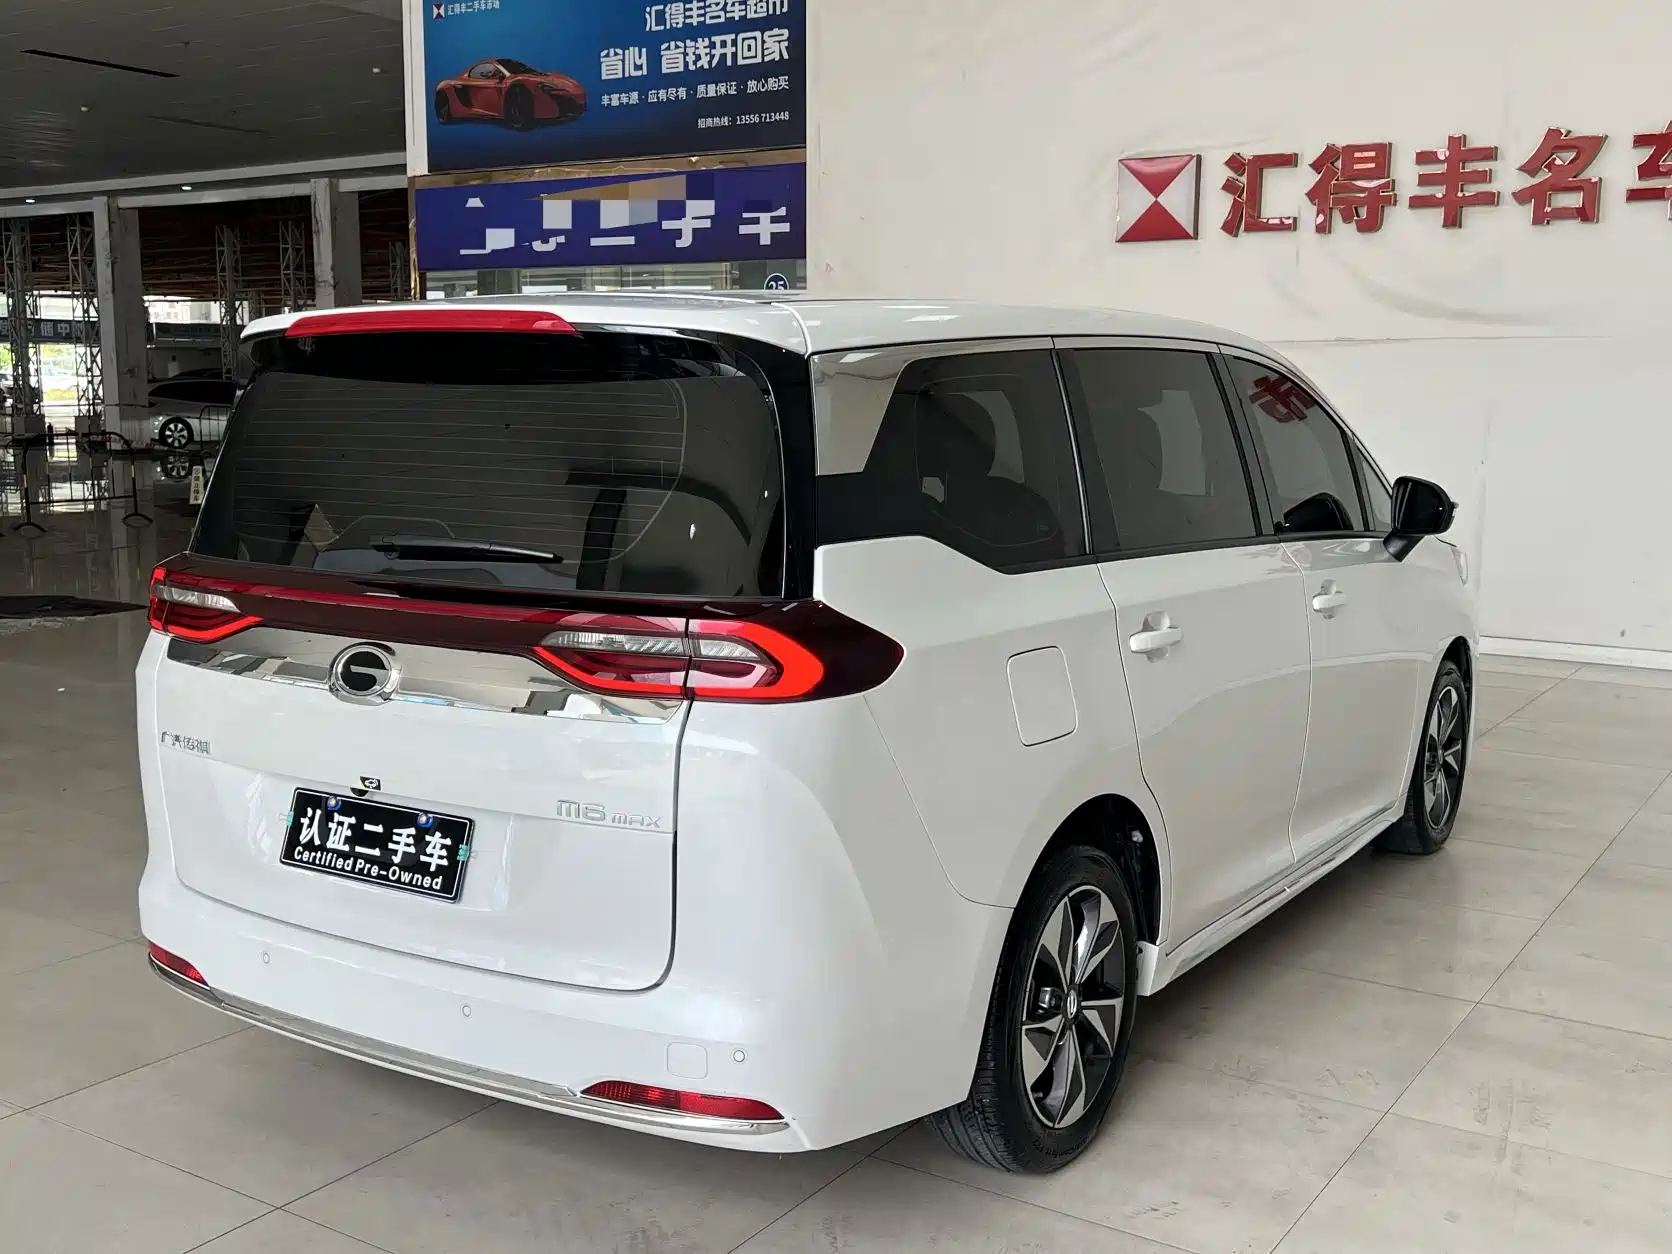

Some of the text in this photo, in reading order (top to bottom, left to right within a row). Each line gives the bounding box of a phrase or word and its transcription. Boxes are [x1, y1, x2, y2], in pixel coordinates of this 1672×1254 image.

[600, 28, 789, 80] 省心 省钱开回家
[299, 806, 452, 872] 认证二手车
[293, 846, 443, 891] Certified Pre-Owned
